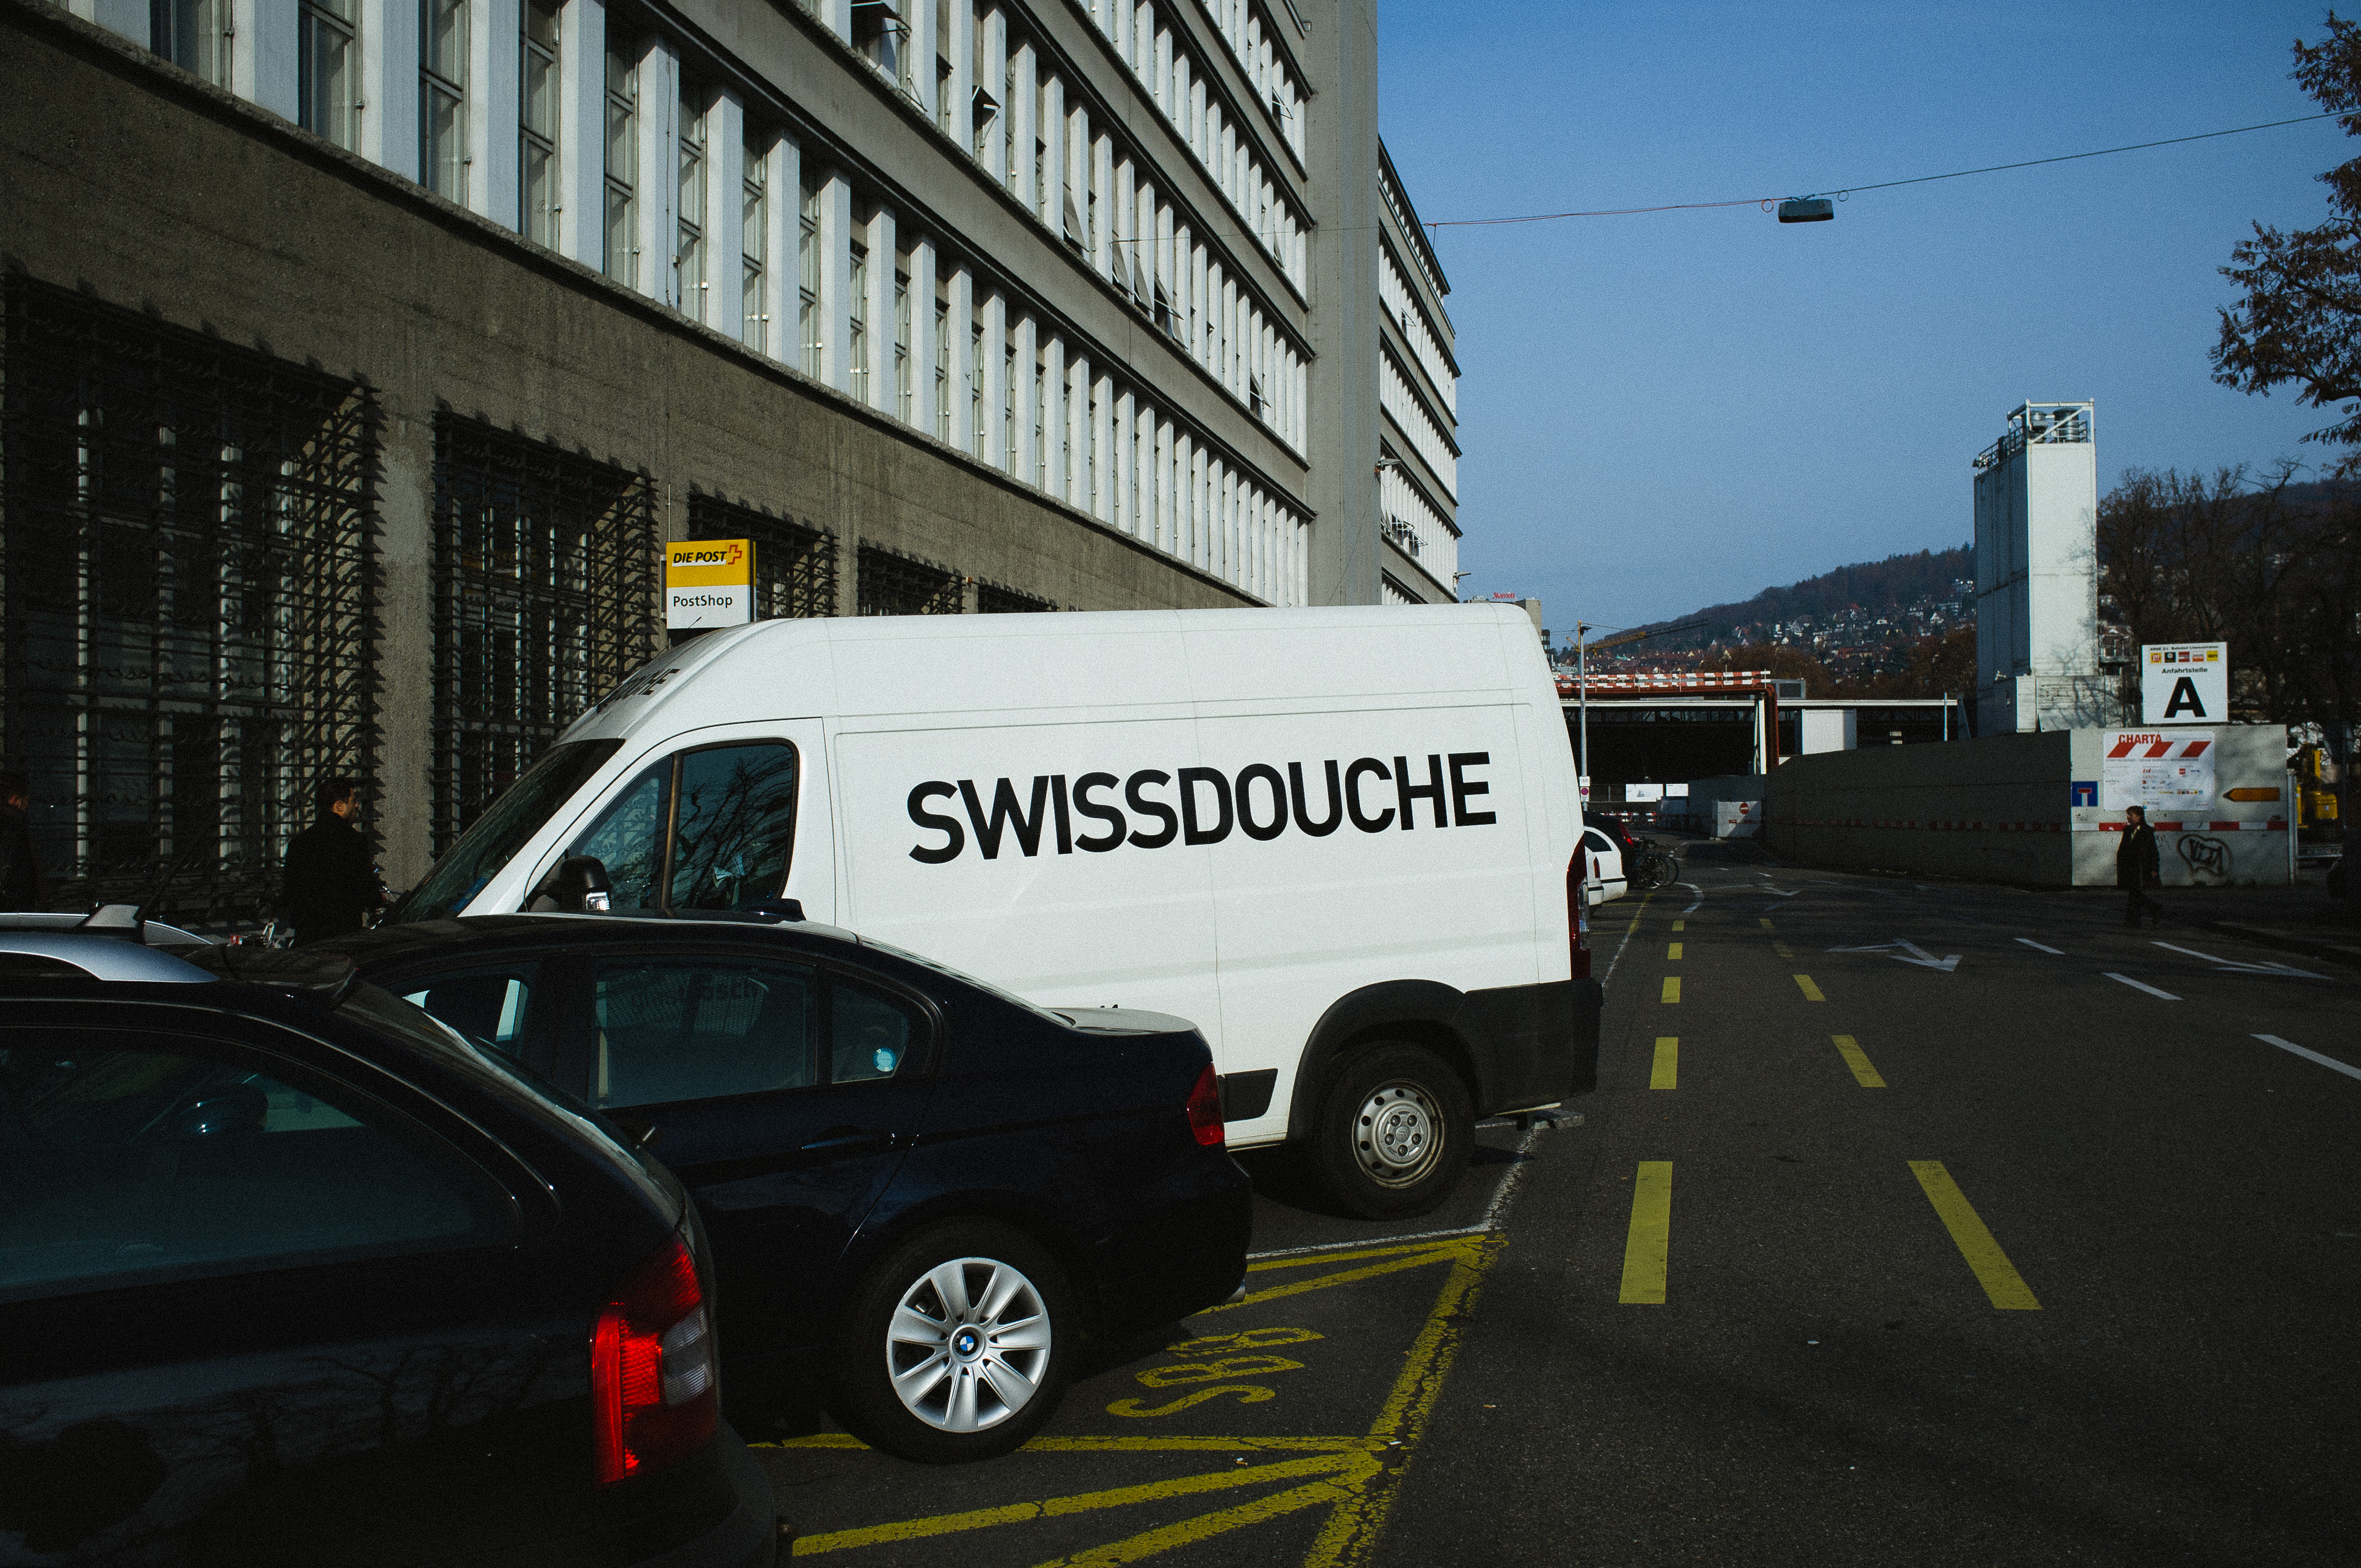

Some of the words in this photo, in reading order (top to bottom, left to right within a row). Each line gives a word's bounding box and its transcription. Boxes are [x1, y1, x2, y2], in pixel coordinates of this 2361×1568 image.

[673, 552, 694, 563] DIE
[695, 551, 727, 563] POST
[673, 595, 733, 608] PostShop
[2163, 677, 2207, 718] A
[2118, 734, 2163, 744] CHARTA
[906, 752, 1498, 864] SWISSDOUCHE
